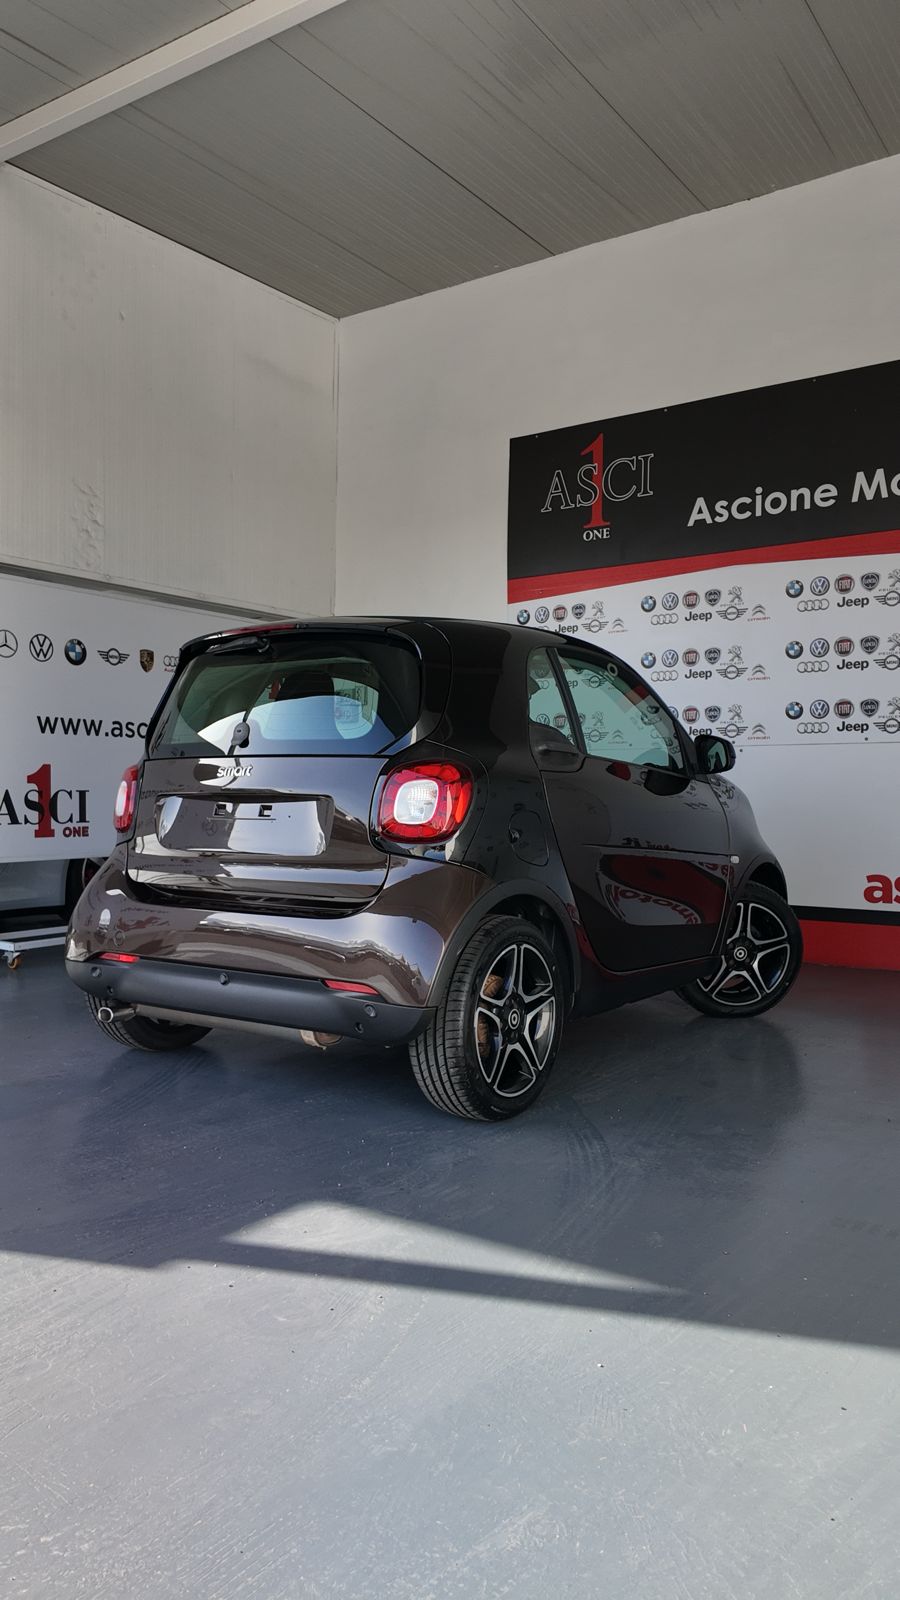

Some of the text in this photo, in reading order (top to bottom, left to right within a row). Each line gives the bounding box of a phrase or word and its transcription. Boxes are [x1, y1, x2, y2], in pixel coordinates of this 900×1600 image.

[541, 453, 655, 513] ASCI
[687, 483, 838, 527] Ascione
[583, 528, 611, 541] ONE
[837, 596, 870, 608] Jeep
[684, 611, 713, 622] Jeep
[554, 624, 579, 634] Jeep
[836, 658, 869, 671] Jeep
[684, 668, 713, 680] Jeep
[836, 721, 869, 733] Jeep
[216, 765, 254, 777] smart
[0, 789, 90, 826] ASCI
[62, 826, 90, 838] ONE
